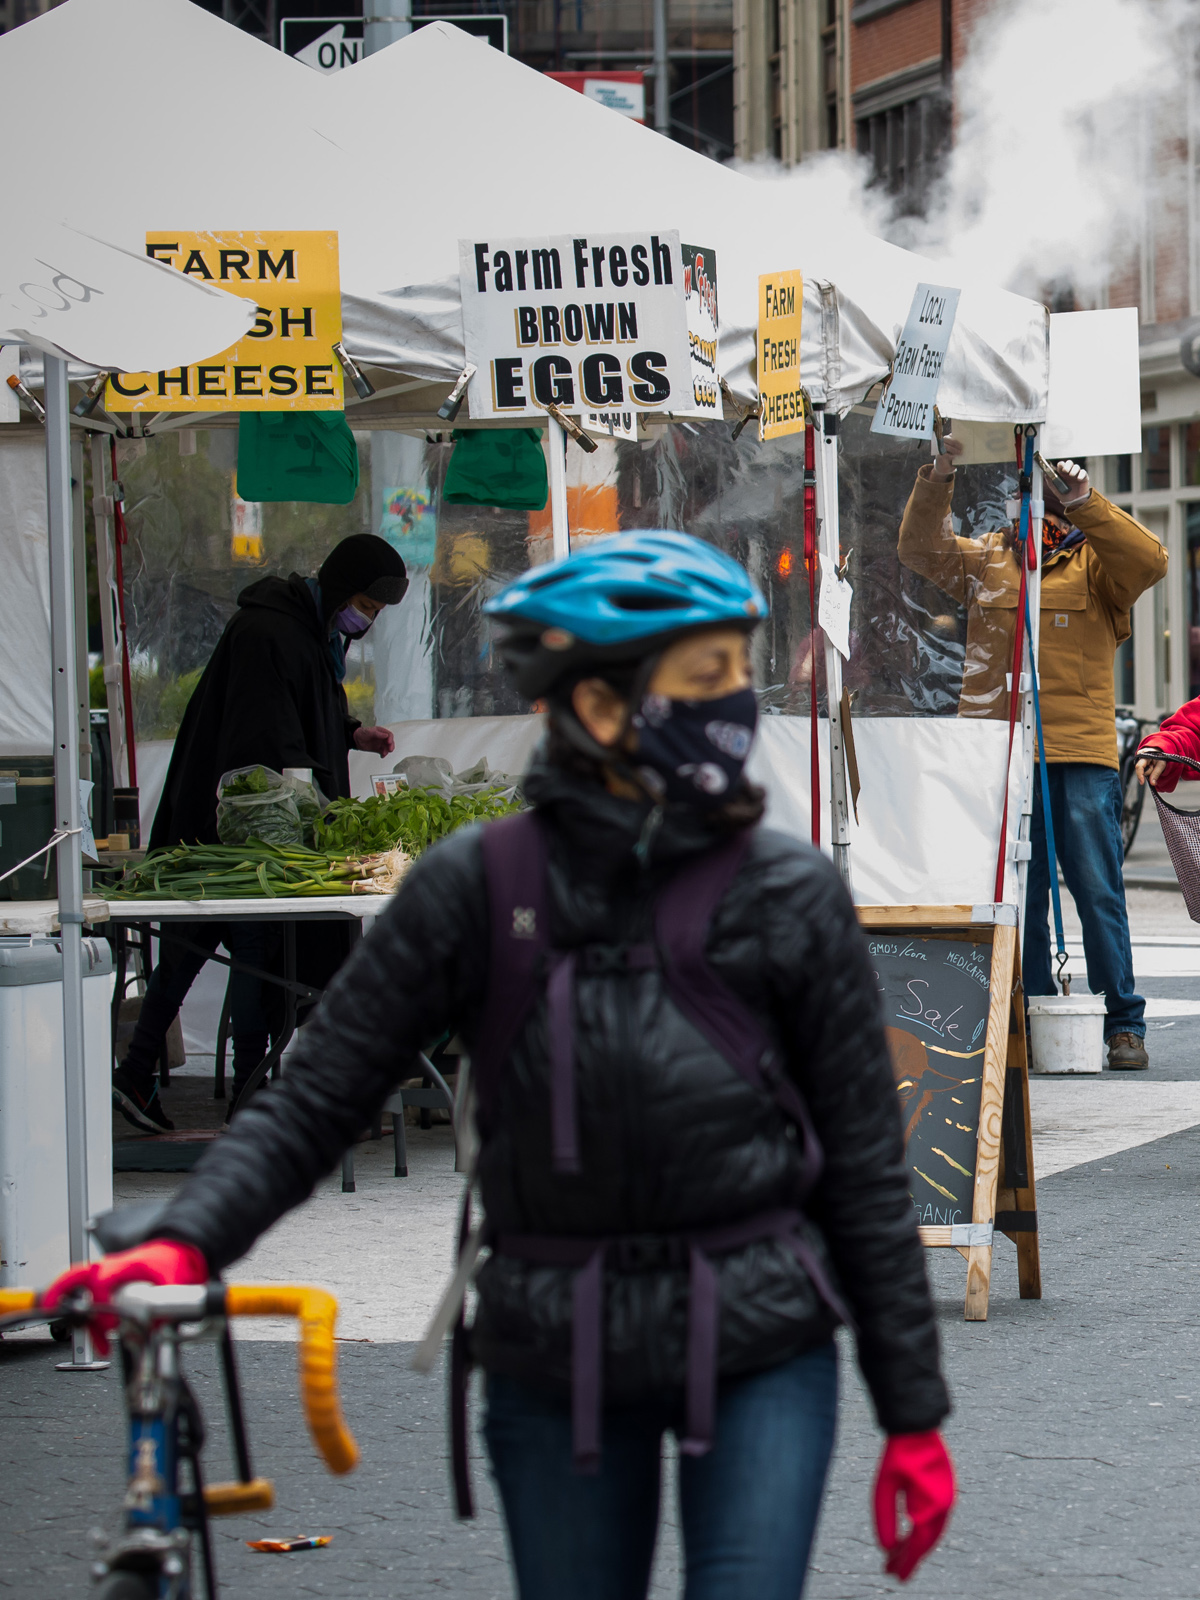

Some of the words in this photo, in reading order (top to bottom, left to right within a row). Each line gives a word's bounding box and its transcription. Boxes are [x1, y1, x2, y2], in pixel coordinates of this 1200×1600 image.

[317, 41, 364, 68] ON
[474, 242, 563, 293] Farm
[572, 235, 673, 289] Fresh
[765, 285, 795, 319] FARM
[919, 290, 947, 326] LOCAL
[514, 302, 639, 349] BROWN
[688, 331, 717, 373] eamy
[763, 338, 797, 372] FRESH
[895, 340, 919, 376] FARM
[916, 343, 945, 379] FRESH
[110, 364, 335, 397] CHEESE
[490, 351, 671, 413] EGGS
[693, 374, 717, 408] tter
[883, 393, 929, 431] PRODUCE
[970, 950, 985, 963] NO
[911, 1199, 962, 1225] GANIC
